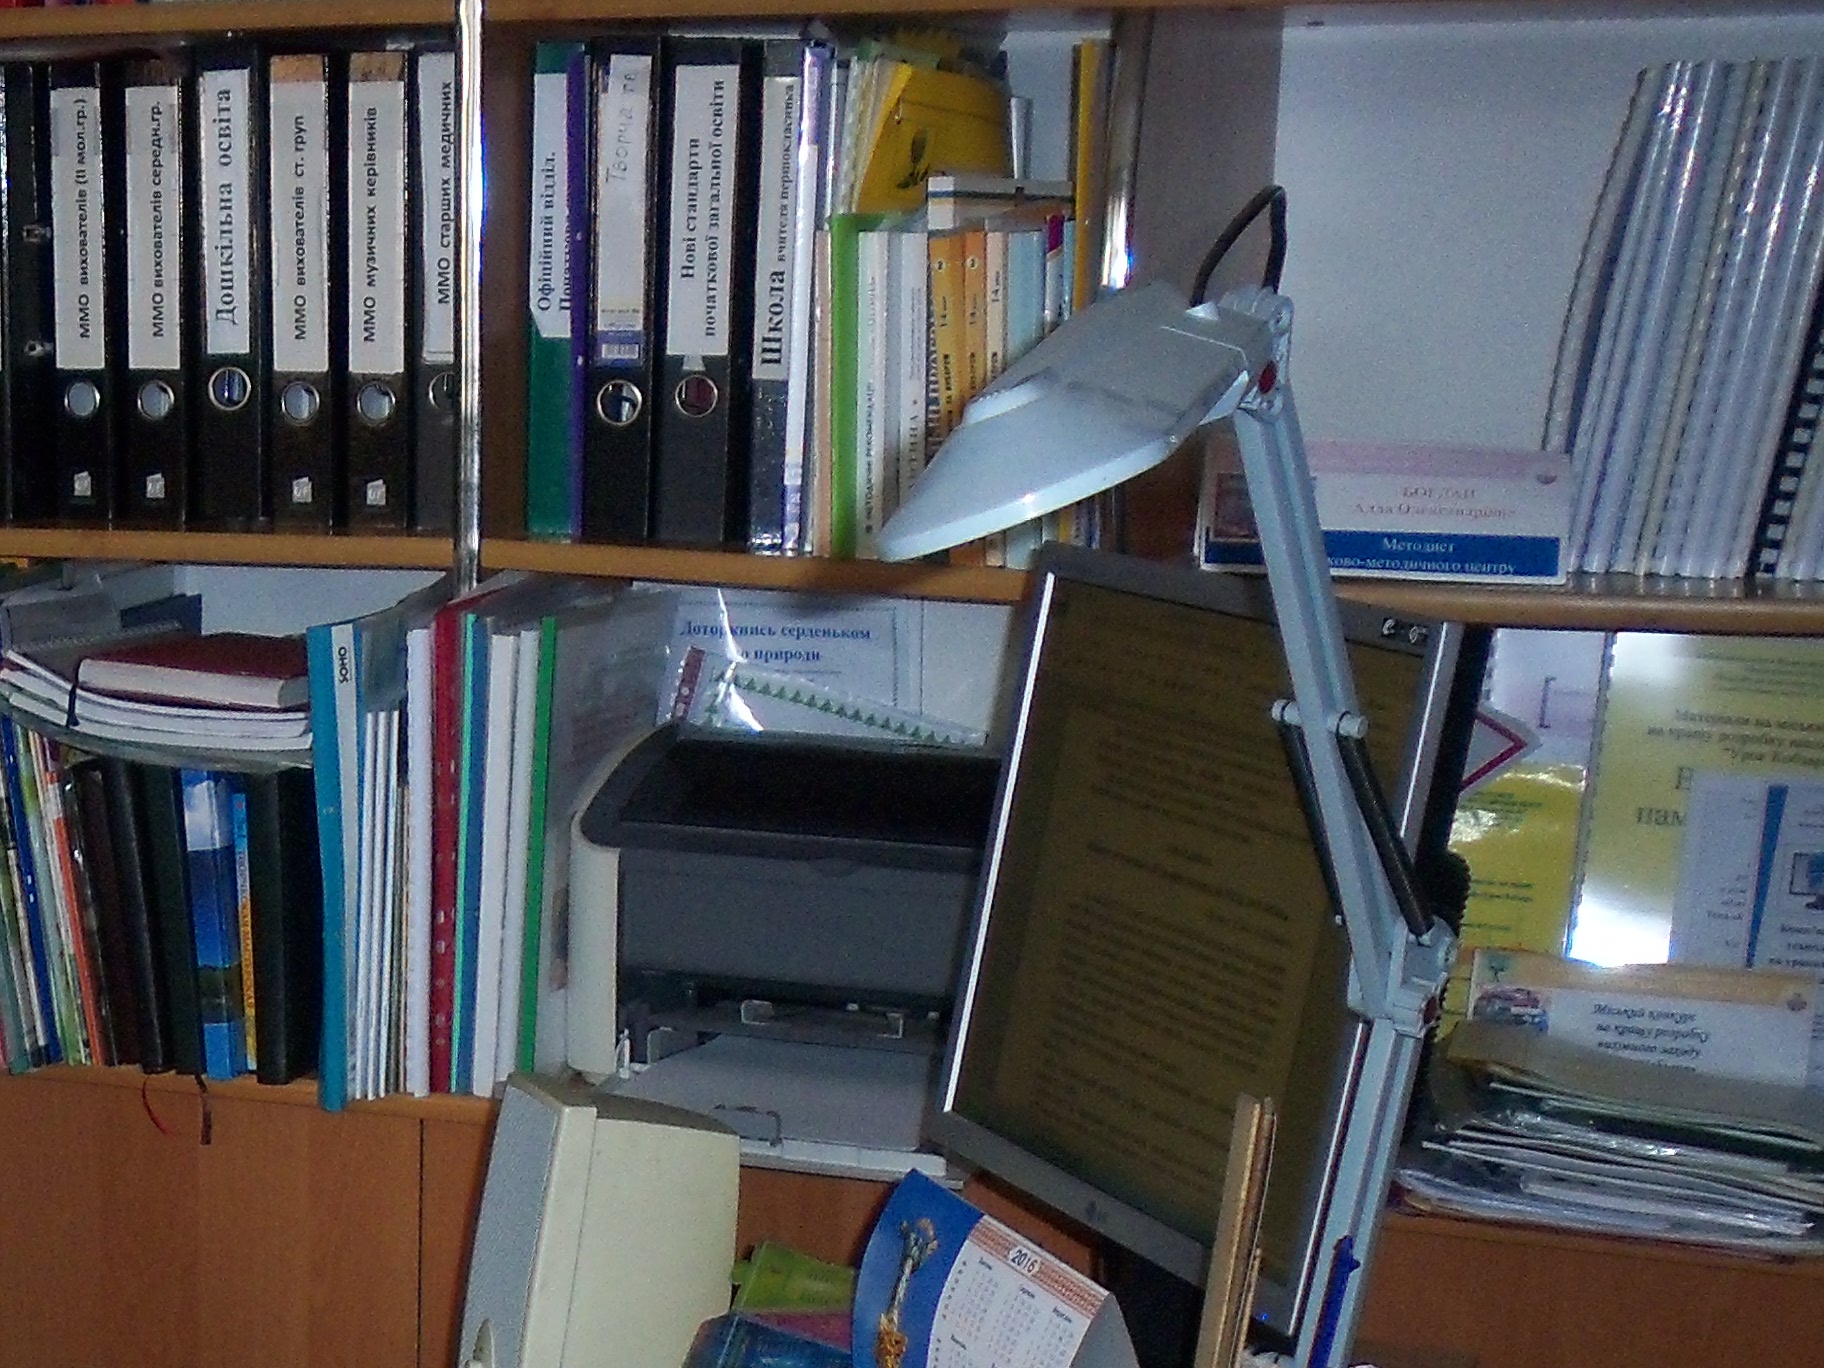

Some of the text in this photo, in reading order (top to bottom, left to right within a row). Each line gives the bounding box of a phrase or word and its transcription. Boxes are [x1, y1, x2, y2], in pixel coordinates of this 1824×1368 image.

[76, 189, 89, 285] вихователів
[150, 101, 164, 337] ММО вихователів середн.гр.
[213, 89, 237, 326] Дошкільна освіта
[292, 115, 308, 340] ММО вихователів ст. груп
[363, 107, 380, 342] ММО музичних керівників
[437, 81, 455, 304] ММО старших медичних
[536, 152, 556, 312] Офіційний відділ.
[681, 138, 703, 279] Нові стандарти
[702, 79, 726, 337] початкової загальної освіти
[78, 293, 91, 339] ММО
[760, 271, 786, 365] Школа
[777, 203, 789, 262] вчителя
[1383, 537, 1455, 553] Методист
[338, 647, 348, 684] SOHO
[754, 650, 820, 663] природи
[781, 624, 870, 640] серденьком
[1010, 1249, 1039, 1275] 2016
